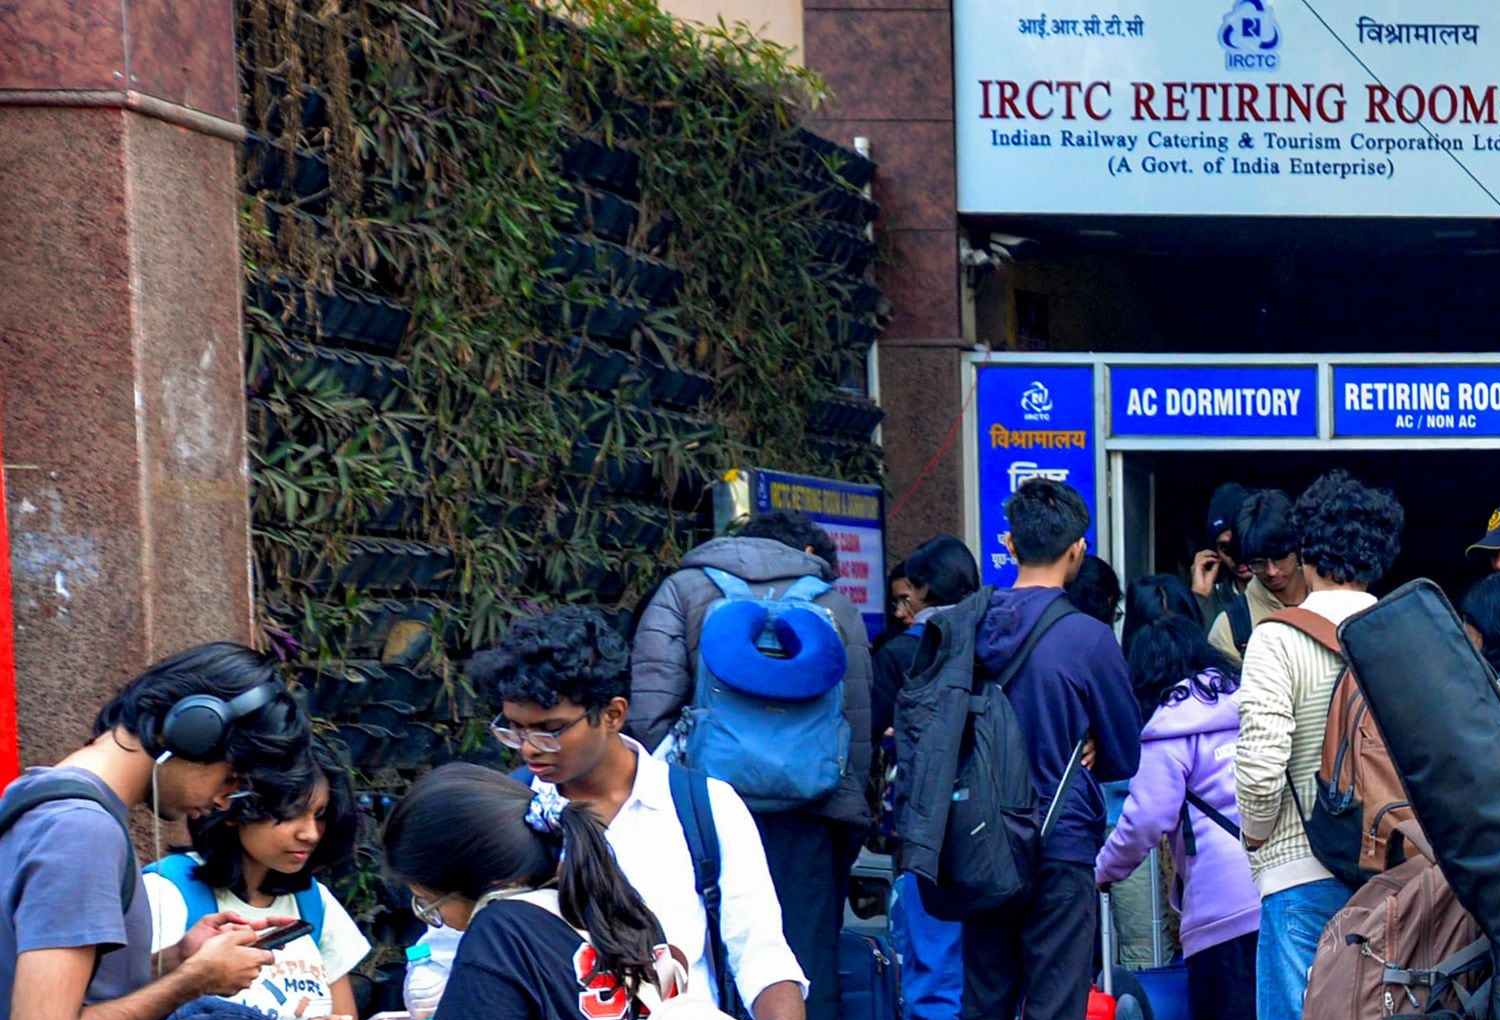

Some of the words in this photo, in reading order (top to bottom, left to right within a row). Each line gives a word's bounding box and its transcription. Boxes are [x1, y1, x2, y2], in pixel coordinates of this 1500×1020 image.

[1357, 16, 1480, 46] विश्रामालय
[1228, 54, 1277, 69] IRCTC
[979, 80, 1112, 120] IRCTC
[1131, 81, 1346, 123] RETIRING
[991, 129, 1052, 147] Indian
[1061, 130, 1138, 152] Railway
[1148, 130, 1229, 153] Catering
[1238, 132, 1255, 149] &
[1264, 132, 1341, 150] Tourism
[1350, 132, 1464, 154] Corporation
[1108, 156, 1132, 176] (A
[1141, 156, 1194, 174] Govt.
[1203, 156, 1226, 174] of
[1232, 157, 1280, 175] India
[1289, 158, 1395, 180] Enterprise)
[1127, 387, 1158, 416] AC
[1166, 388, 1301, 416] DORMITORY
[1344, 382, 1450, 411] RETIRING
[1395, 415, 1414, 429] AC
[1416, 414, 1424, 430] /
[1427, 415, 1455, 429] NON
[1458, 415, 1477, 429] AC
[990, 428, 1086, 449] विश्रामालय
